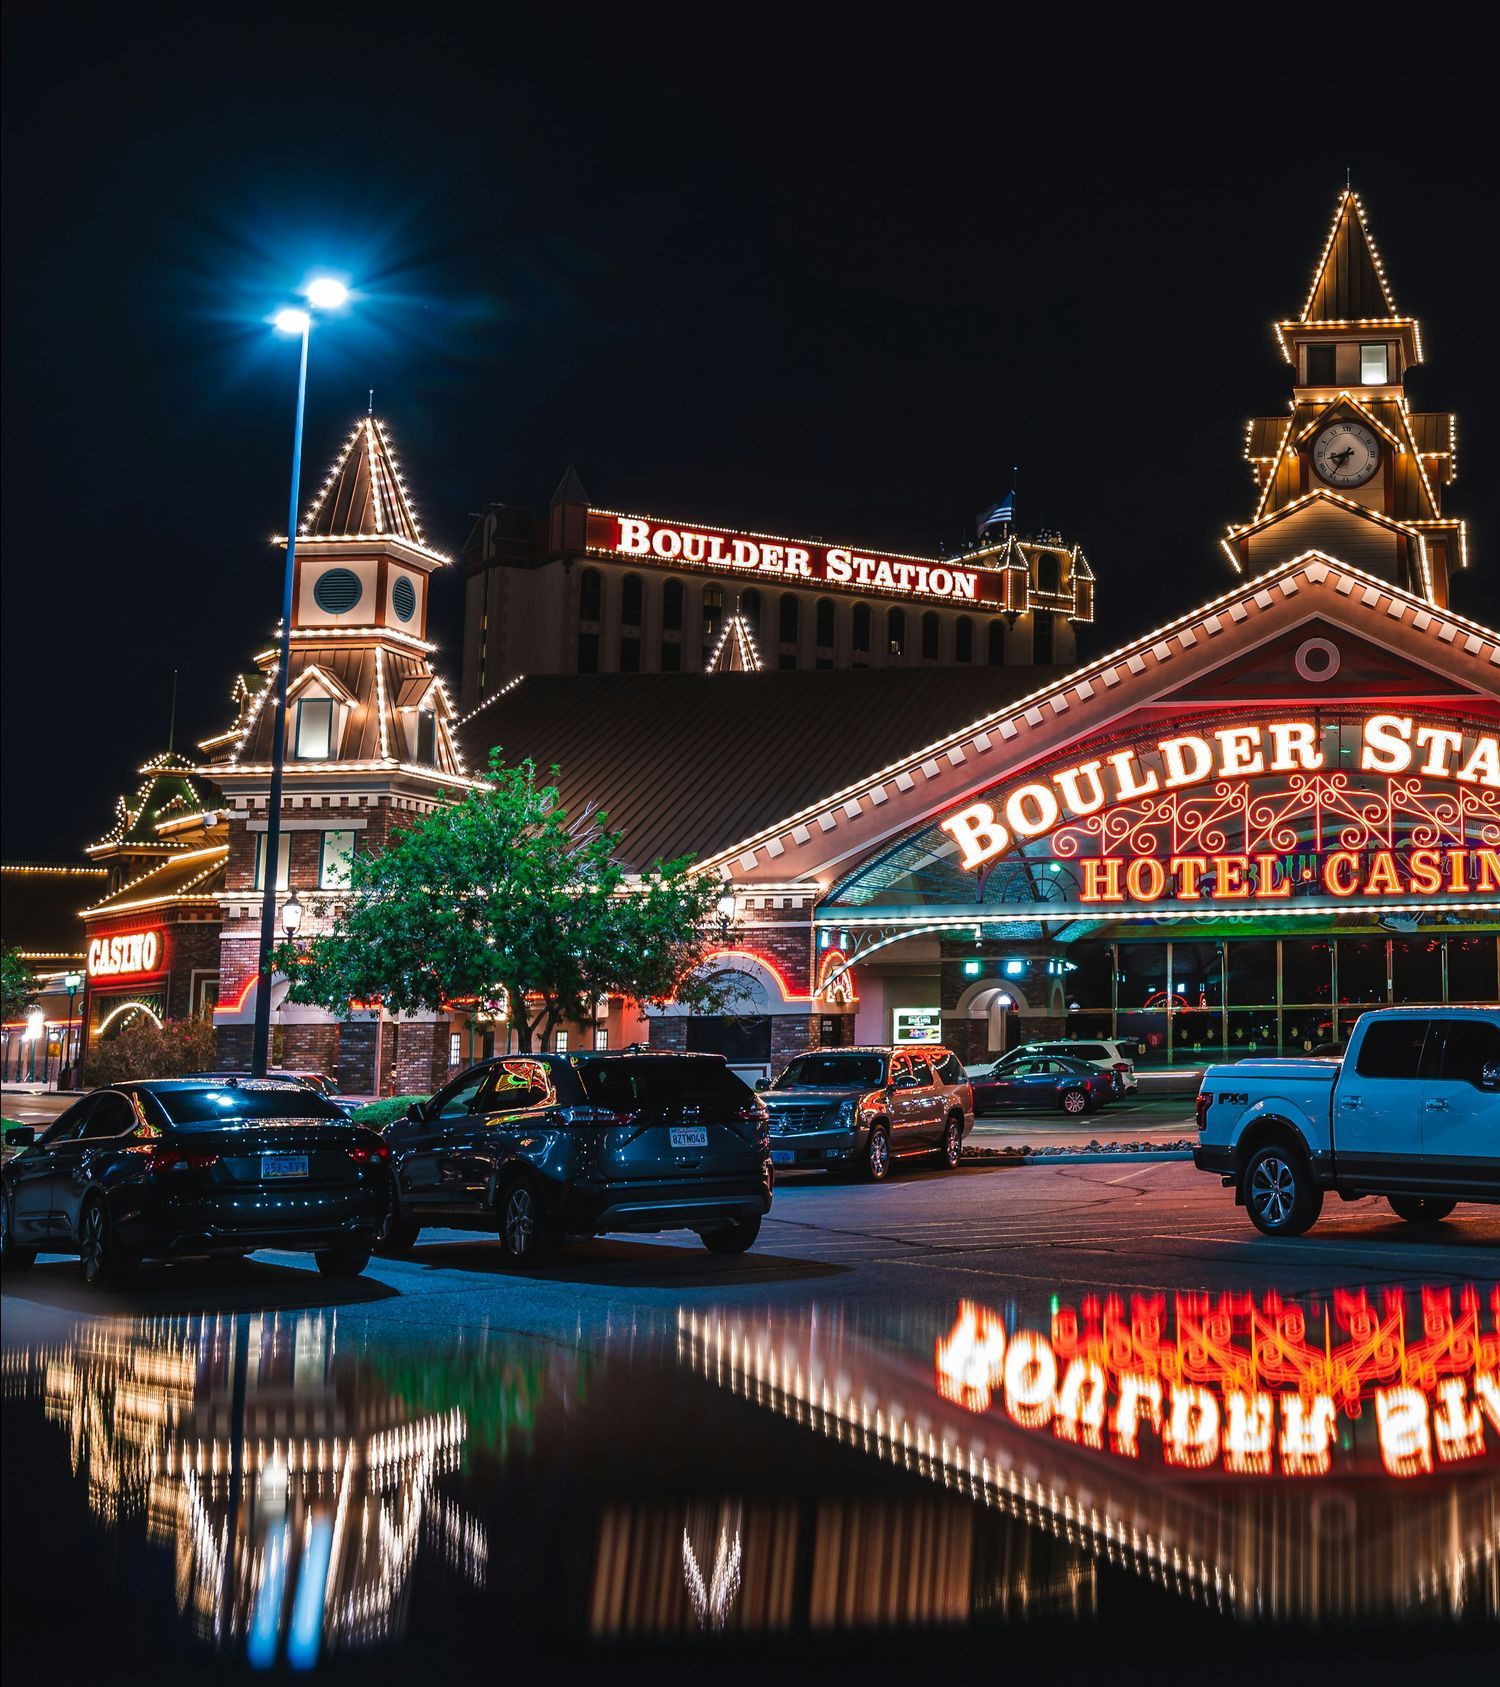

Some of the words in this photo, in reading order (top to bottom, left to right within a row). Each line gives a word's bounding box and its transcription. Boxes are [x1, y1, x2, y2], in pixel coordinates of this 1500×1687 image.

[615, 517, 812, 576] BOULDER
[825, 548, 978, 599] STATION
[941, 722, 1325, 872] BOULDER
[1079, 854, 1291, 902] HOTEL
[89, 931, 157, 977] CASINO
[1218, 1092, 1249, 1105] FX4
